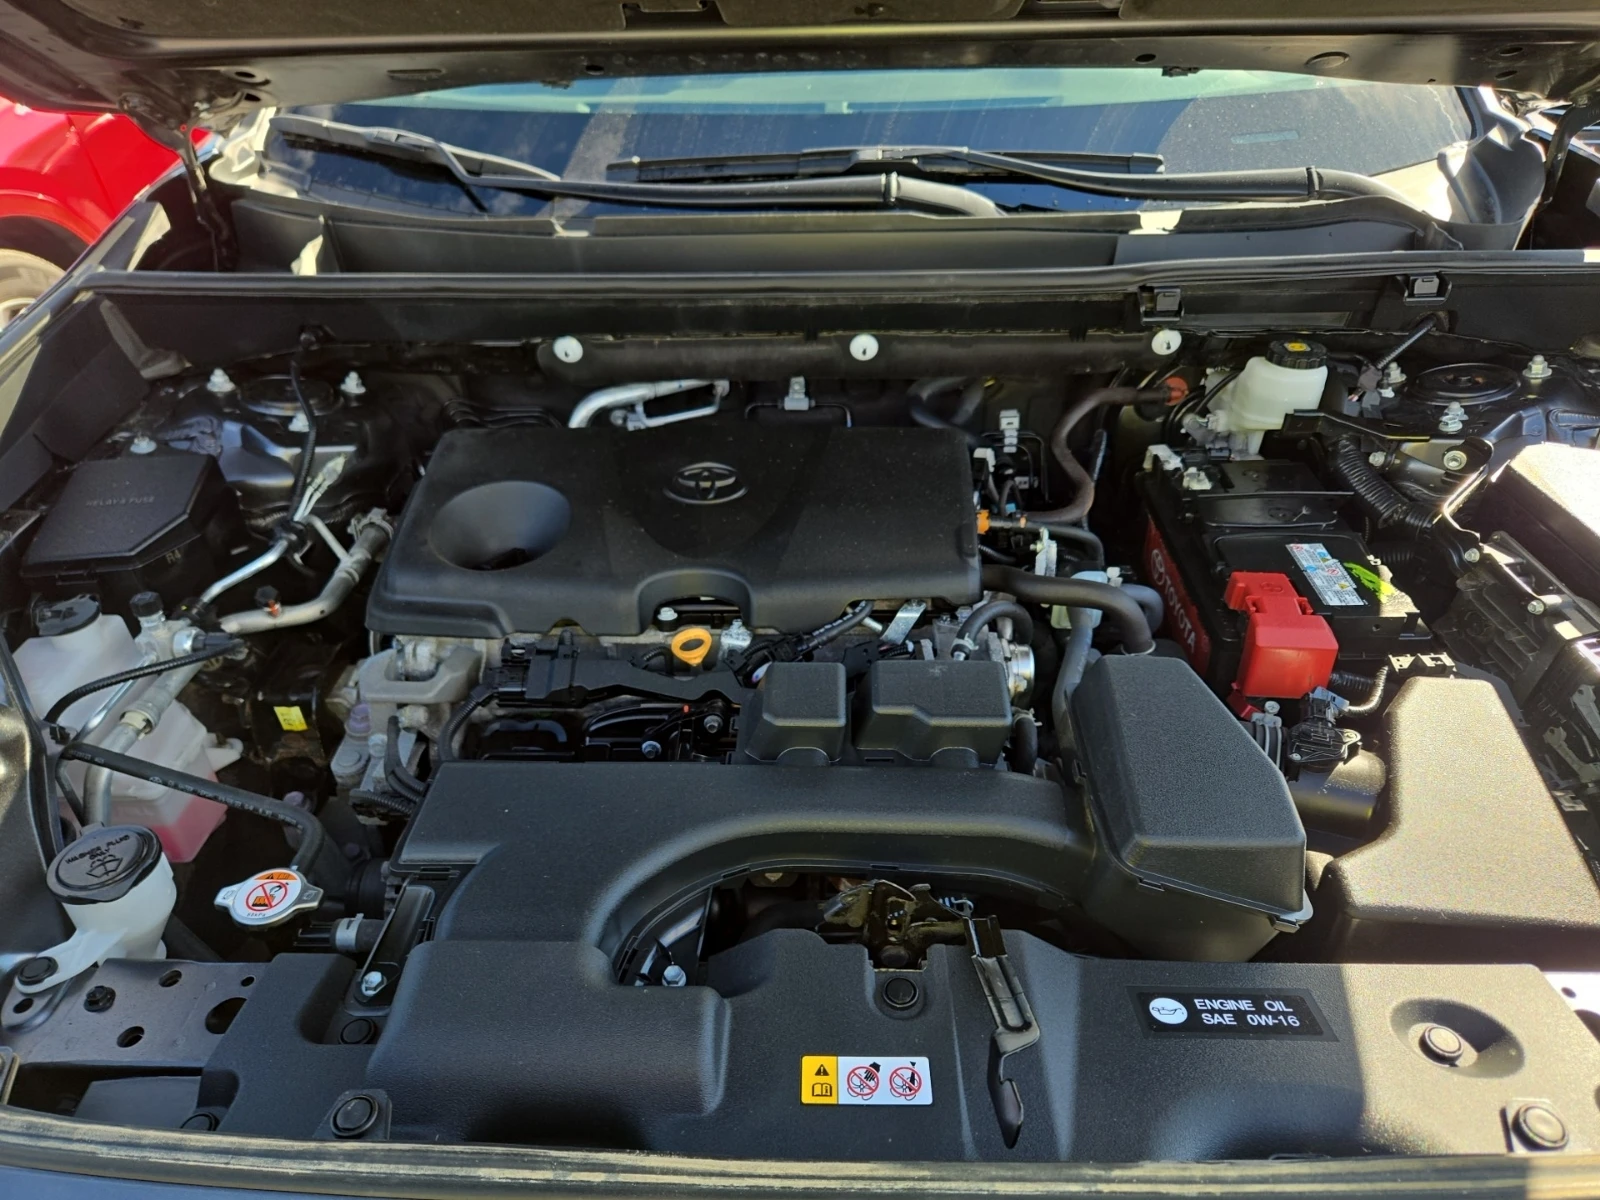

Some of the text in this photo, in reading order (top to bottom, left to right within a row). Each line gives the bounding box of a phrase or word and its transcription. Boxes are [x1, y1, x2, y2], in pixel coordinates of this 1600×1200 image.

[1164, 576, 1196, 653] TOYOTA
[1194, 998, 1293, 1012] ENGINE OIL
[1201, 1013, 1300, 1027] SAE 0W-16
